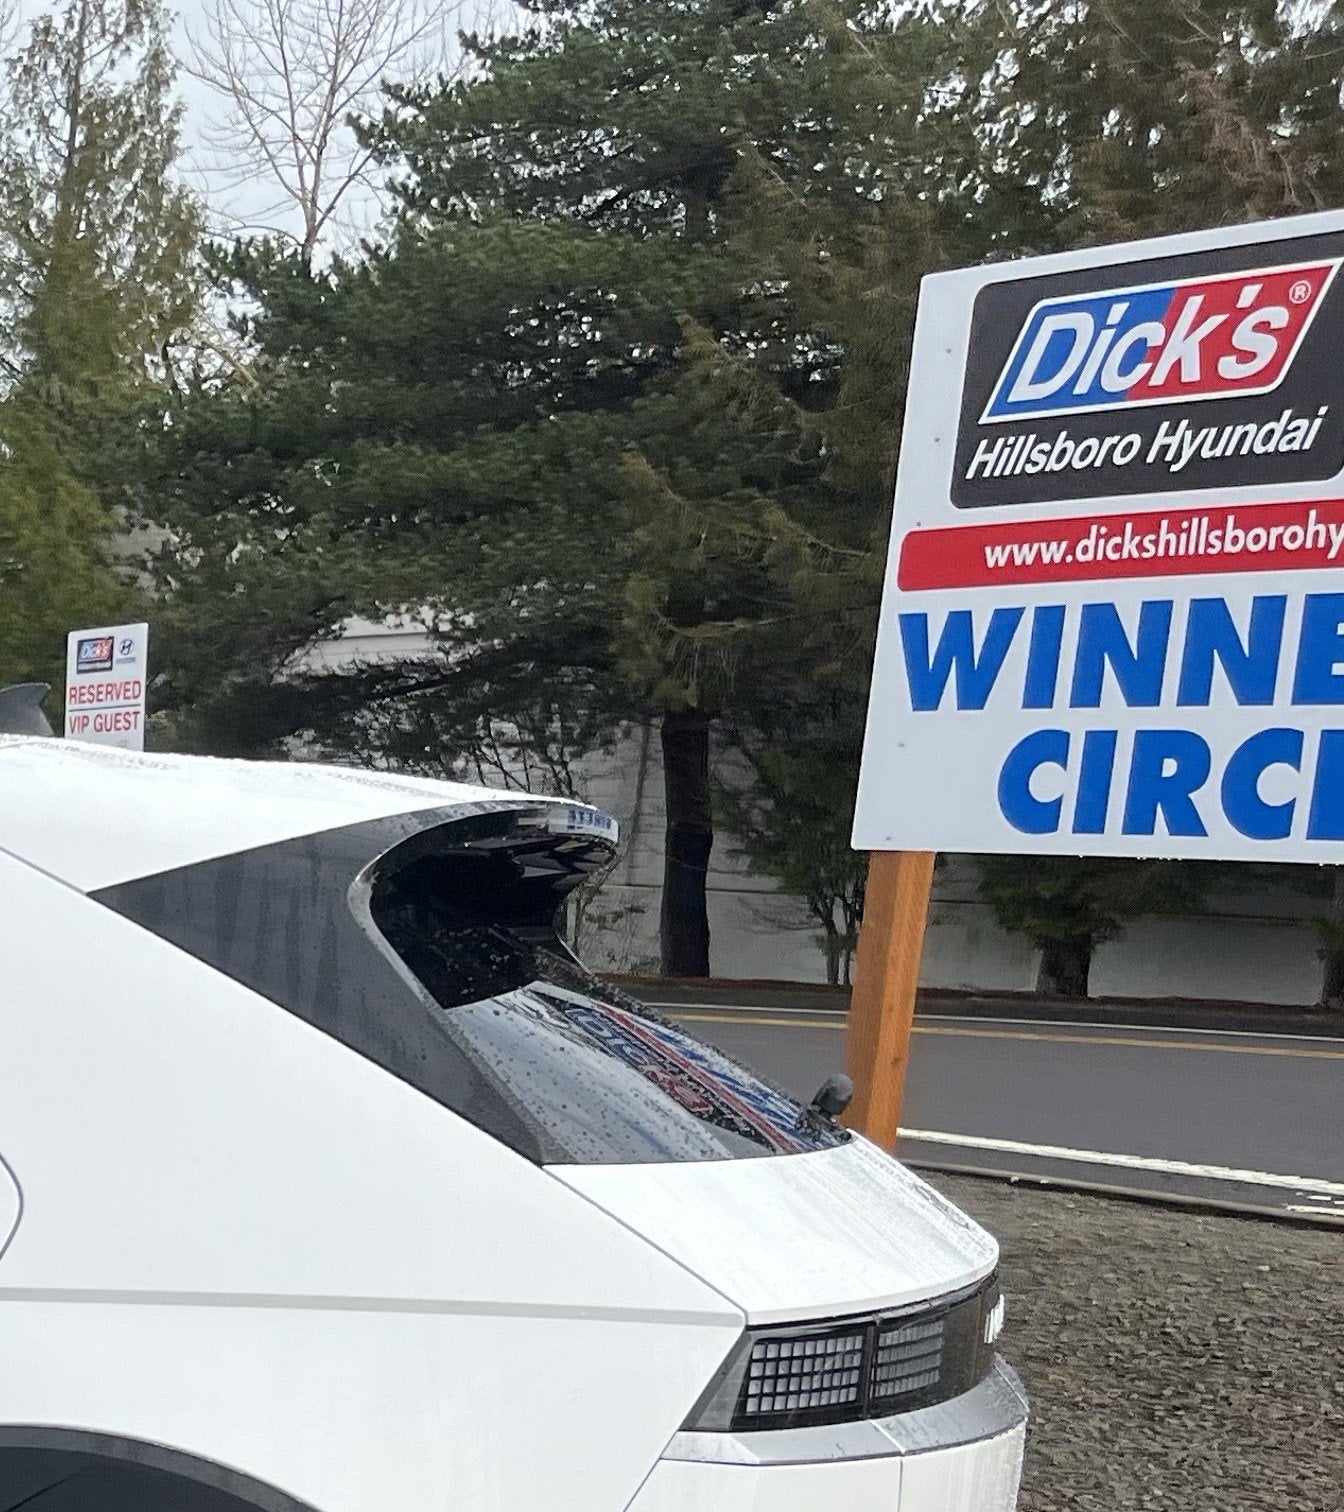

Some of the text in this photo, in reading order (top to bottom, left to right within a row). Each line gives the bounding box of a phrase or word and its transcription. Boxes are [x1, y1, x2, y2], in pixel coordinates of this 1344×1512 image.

[1007, 284, 1289, 403] Dick's
[965, 406, 1329, 479] Hillsboro Hyundai
[69, 681, 142, 705] RESERVED
[69, 711, 140, 735] VIP GUEST
